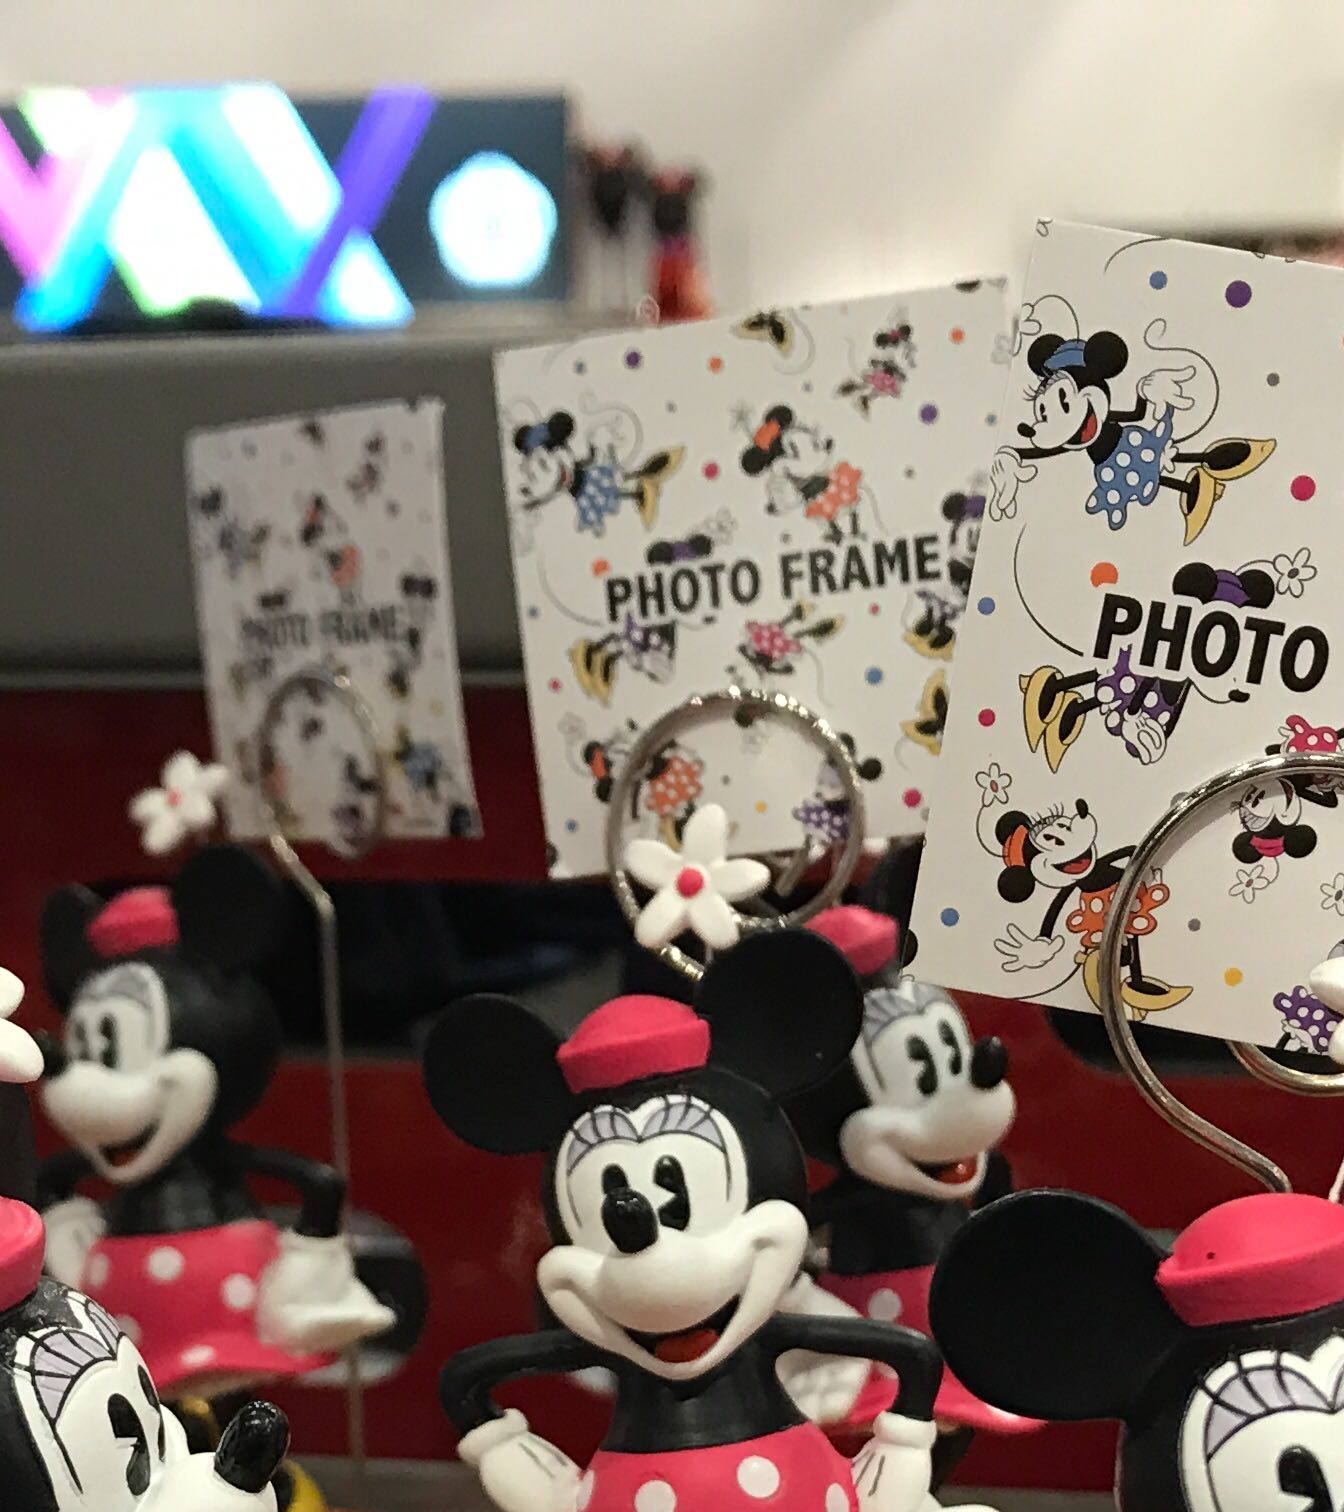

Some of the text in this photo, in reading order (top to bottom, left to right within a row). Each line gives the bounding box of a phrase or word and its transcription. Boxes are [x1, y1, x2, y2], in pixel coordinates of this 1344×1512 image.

[606, 534, 941, 623] PHOTO FRAME
[1093, 593, 1329, 693] PHOTO
